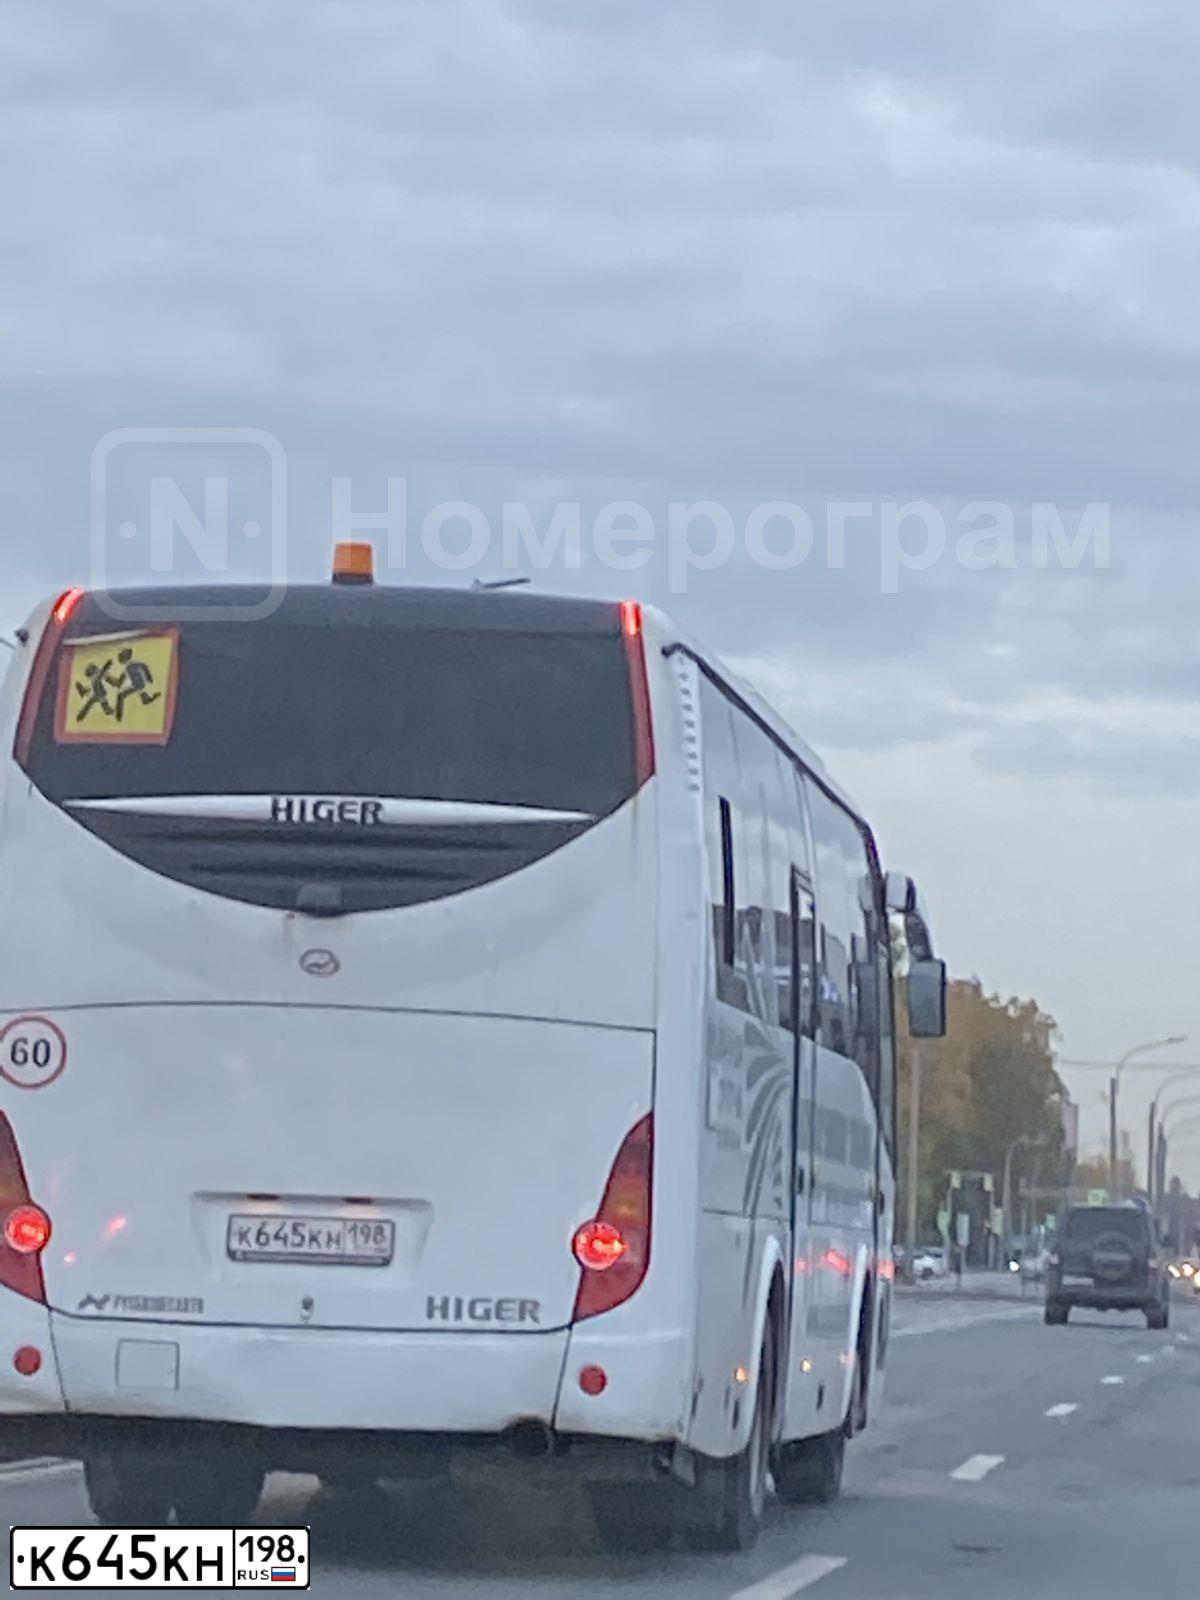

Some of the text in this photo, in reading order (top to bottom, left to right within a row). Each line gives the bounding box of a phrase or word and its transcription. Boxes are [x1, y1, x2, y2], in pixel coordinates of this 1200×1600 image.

[269, 796, 385, 825] HIGER
[10, 1037, 52, 1068] 60
[426, 1296, 541, 1323] HIGER
